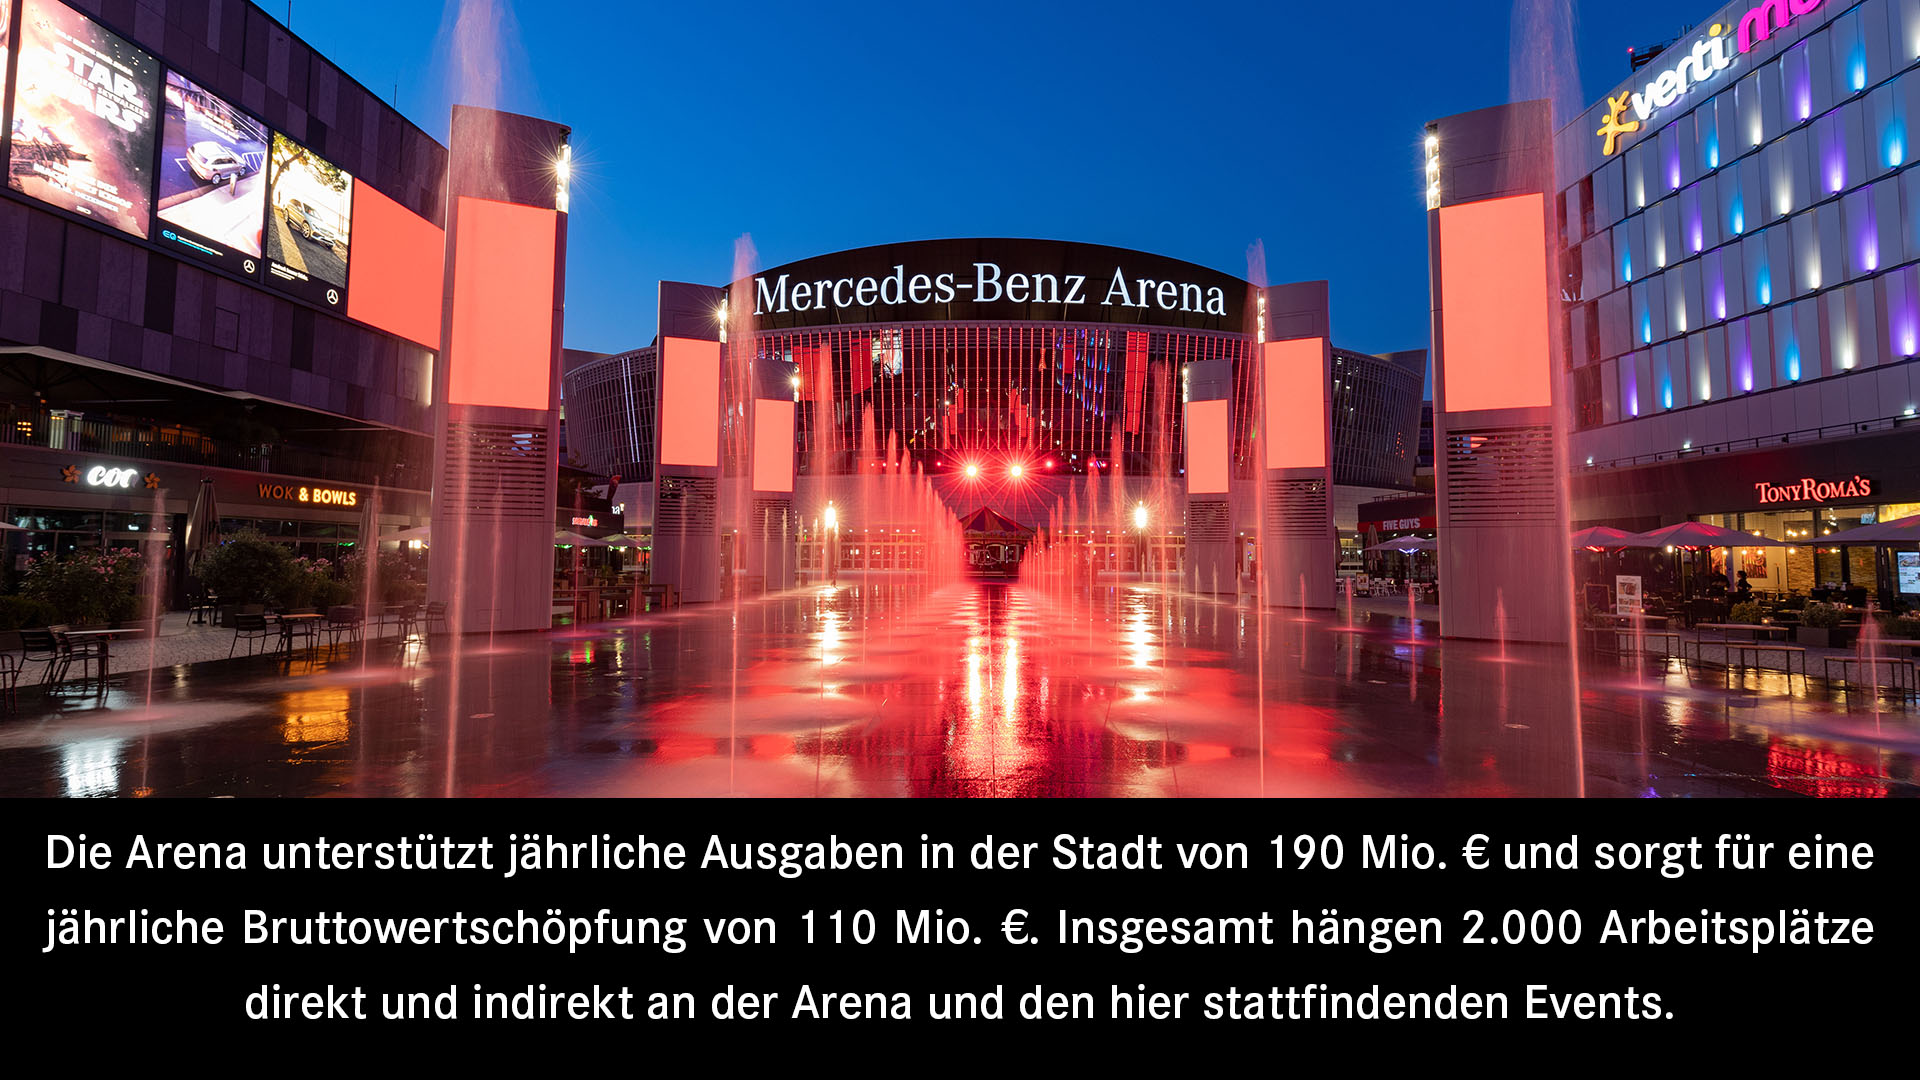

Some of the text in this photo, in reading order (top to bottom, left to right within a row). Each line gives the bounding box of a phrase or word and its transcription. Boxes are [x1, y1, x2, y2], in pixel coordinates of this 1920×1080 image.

[1630, 23, 1730, 120] verti
[753, 262, 1227, 316] Mercedes-Benz Arena
[258, 483, 357, 507] WOK & BOWLS
[1382, 517, 1421, 530] FIVE GUYS
